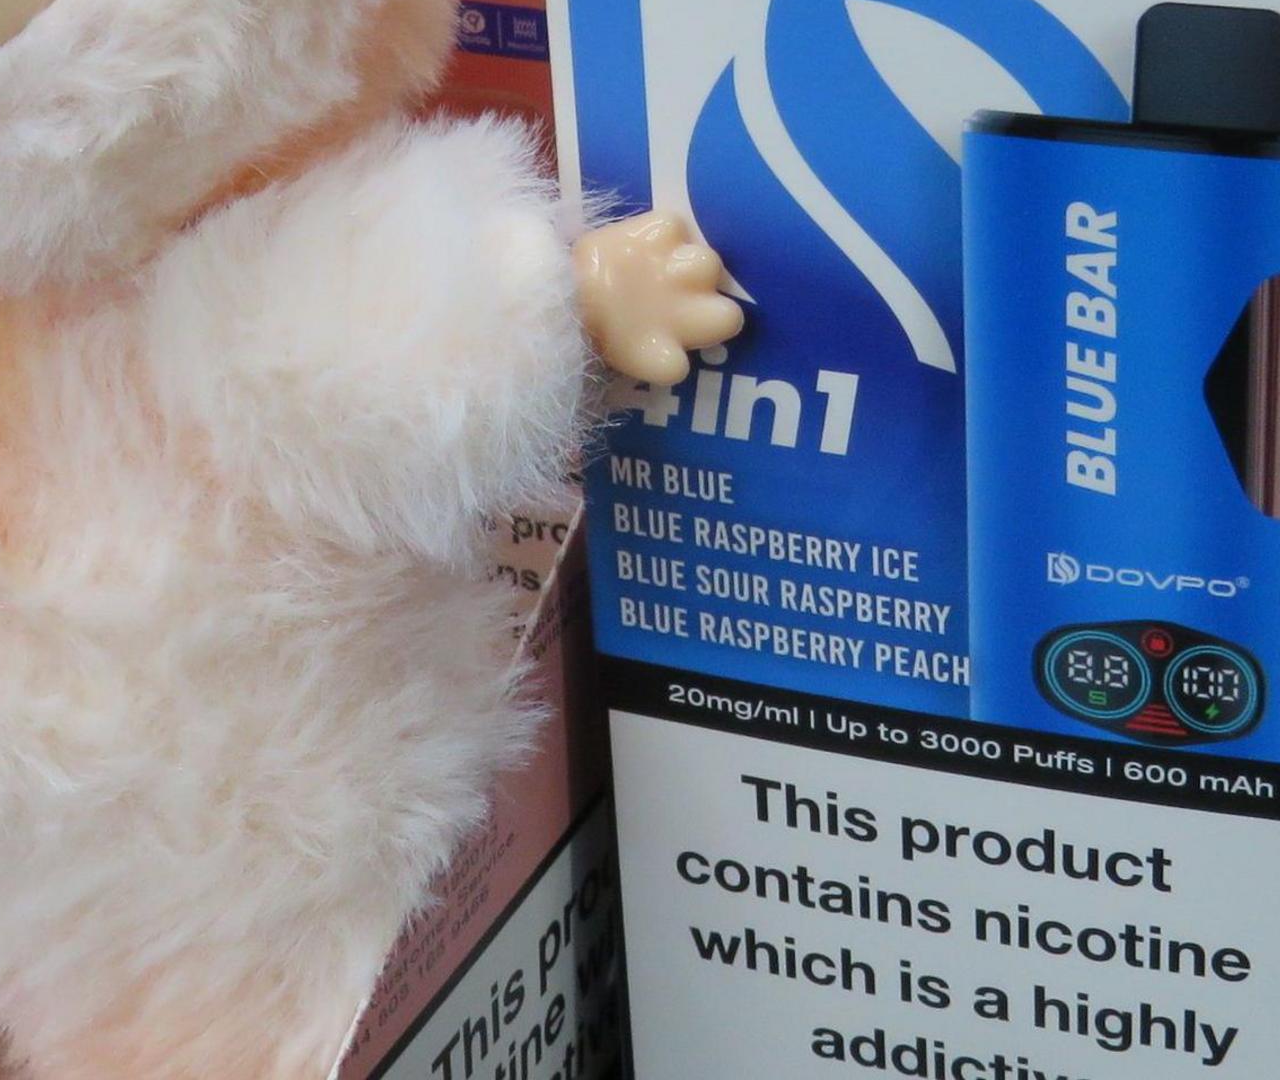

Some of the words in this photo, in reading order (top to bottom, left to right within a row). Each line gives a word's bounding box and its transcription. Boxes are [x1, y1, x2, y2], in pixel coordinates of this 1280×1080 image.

[1066, 201, 1119, 340] BAR
[1065, 341, 1118, 496] BLUE
[610, 455, 652, 491] MR
[662, 463, 734, 506] BLUE
[614, 503, 683, 543] BLUE
[694, 517, 861, 573] RASPBERRY
[871, 546, 920, 582] ICE
[617, 550, 687, 591] BLUE
[695, 563, 771, 607] SOUR
[779, 579, 951, 636] RASPBERRY
[619, 596, 689, 639] BLUE
[699, 611, 865, 670] RASPBERRY
[875, 643, 971, 688] PEACH
[1182, 665, 1241, 702] 100
[667, 682, 801, 726] 20mg/ml
[825, 714, 869, 745] Up
[876, 722, 910, 746] to
[920, 728, 1002, 761] 3000
[1012, 743, 1097, 777] Puffs
[1122, 759, 1188, 789] 600
[1199, 771, 1276, 800] mAh
[740, 774, 878, 843] This
[901, 813, 1173, 893] product
[675, 849, 952, 935] contains
[974, 903, 1253, 983] nicotine
[431, 968, 525, 1080] This
[689, 923, 877, 996] which
[898, 960, 952, 1010] is
[972, 983, 1010, 1021] a
[1032, 984, 1240, 1068] highly
[811, 1025, 1092, 1080] addicti
